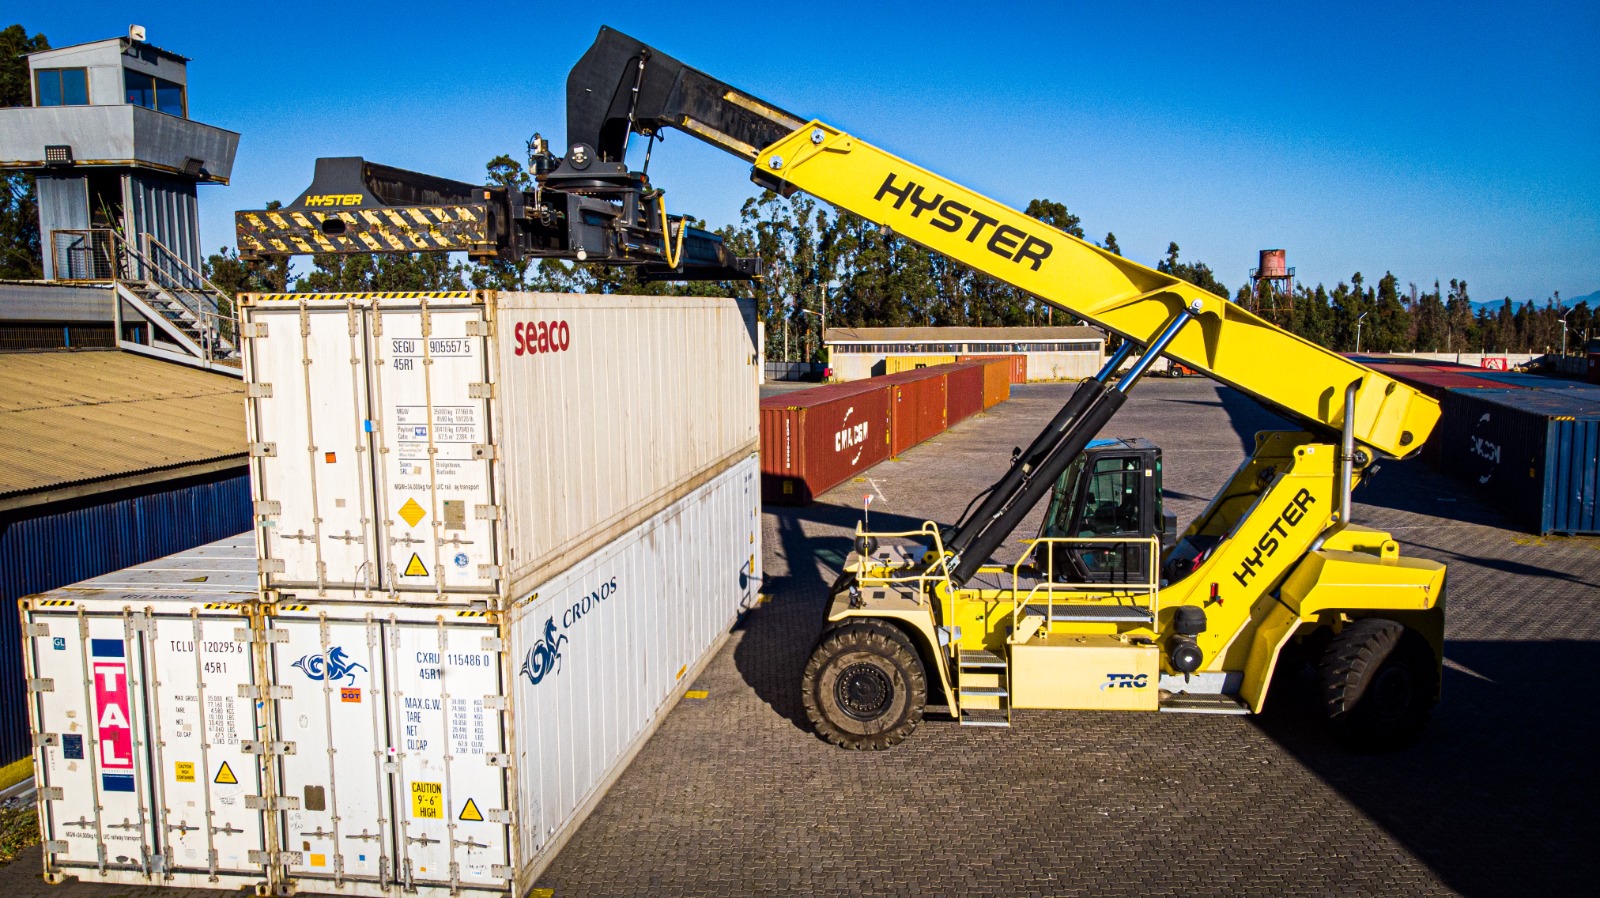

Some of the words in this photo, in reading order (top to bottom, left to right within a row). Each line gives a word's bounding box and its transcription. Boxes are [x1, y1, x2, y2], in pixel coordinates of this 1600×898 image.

[305, 194, 362, 206] HYSTER
[874, 172, 1053, 272] HYSTER
[514, 320, 570, 356] seaco
[392, 340, 414, 353] SEGU
[430, 341, 462, 353] 905557
[464, 340, 470, 352] 5
[394, 359, 413, 370] 45R1
[1232, 488, 1316, 588] HYSTER
[563, 576, 617, 628] CRONOS
[171, 641, 194, 652] TCLU
[203, 642, 234, 653] 120295
[238, 643, 243, 653] 6
[416, 652, 440, 664] CXRU
[448, 654, 481, 666] 115486
[204, 662, 227, 673] 45R1
[420, 669, 441, 679] 45R1
[405, 698, 441, 710] MAX.G.W.
[94, 666, 130, 765] TAL
[406, 711, 421, 723] TARE
[407, 726, 417, 736] NET
[412, 783, 441, 794] CAUTION
[420, 807, 436, 817] HIGH
